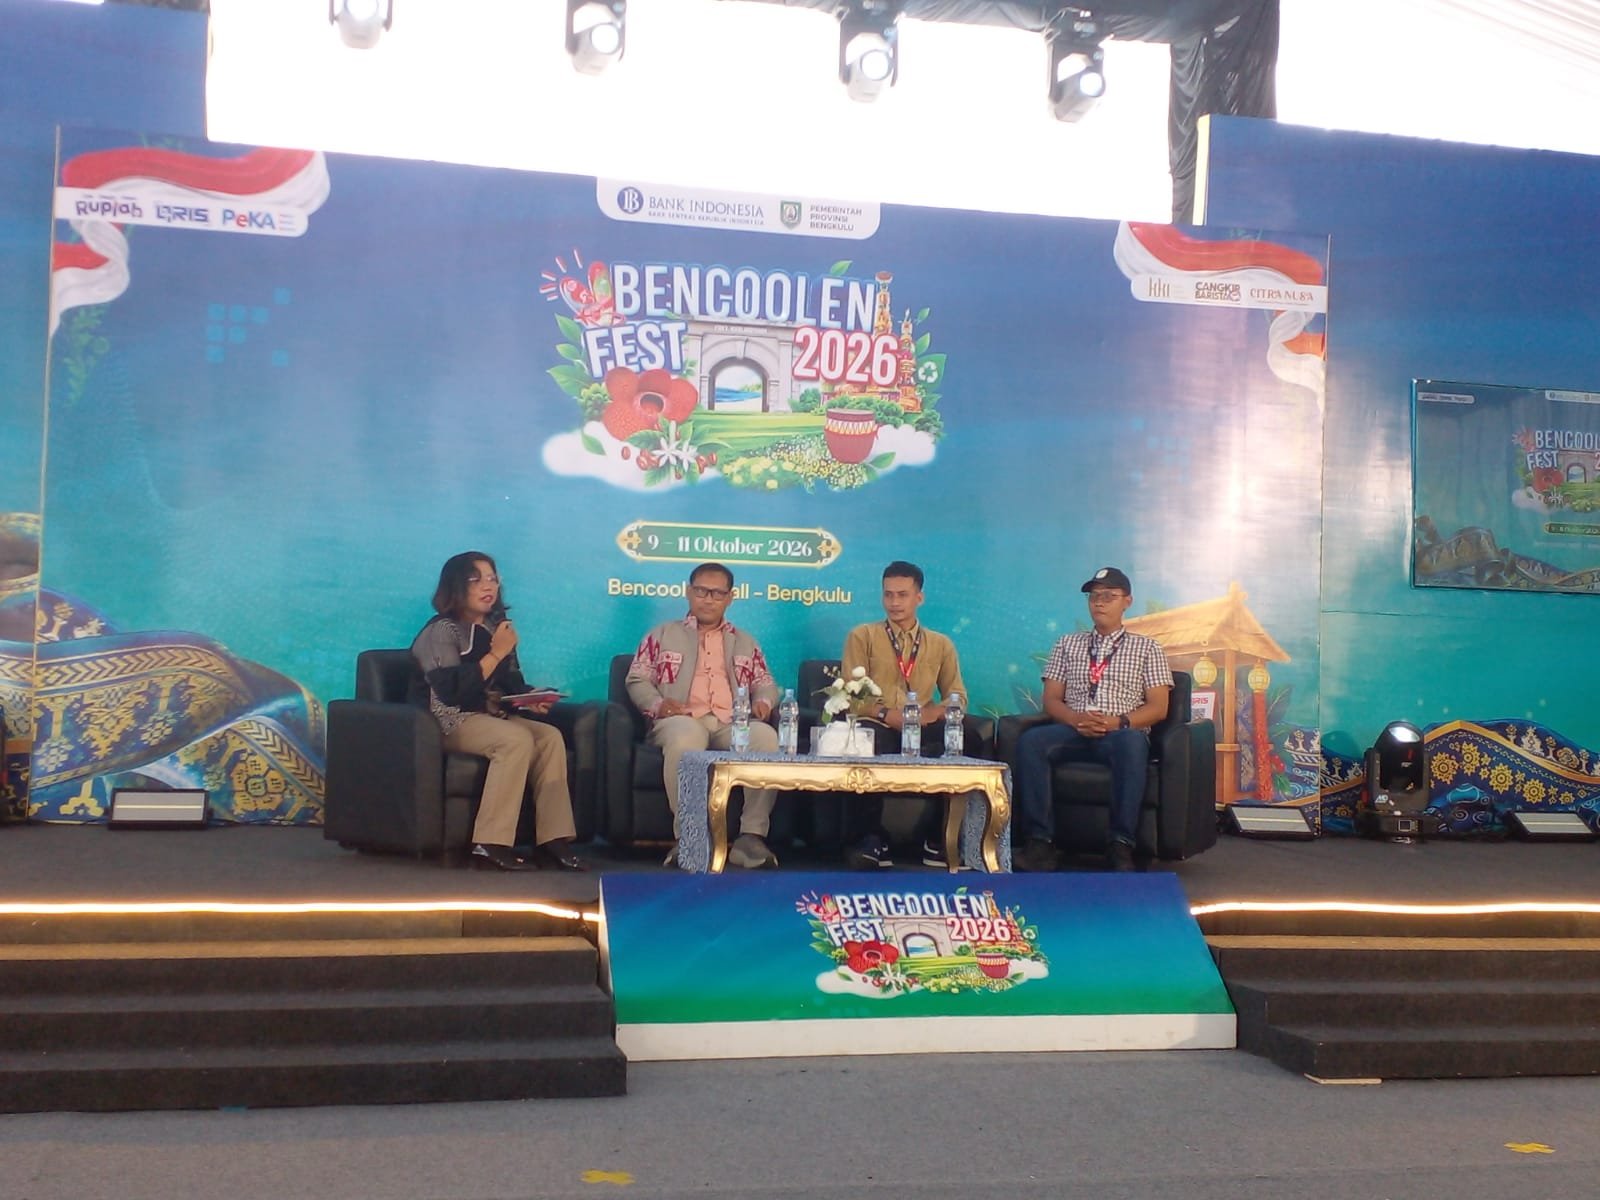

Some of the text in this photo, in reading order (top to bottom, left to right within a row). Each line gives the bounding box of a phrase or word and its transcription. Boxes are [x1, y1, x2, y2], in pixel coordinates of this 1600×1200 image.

[649, 196, 764, 218] BANK INDONESIA
[810, 204, 863, 217] PEMERINTAH
[810, 213, 849, 223] PROVINSI
[222, 209, 276, 230] PeKA
[810, 221, 855, 231] BENGKULU
[1195, 281, 1241, 292] CANGKIR
[1250, 288, 1282, 300] CITRA
[613, 264, 877, 332] BENCOOLEN
[585, 322, 687, 378] FEST
[793, 326, 900, 385] 2026
[1526, 450, 1559, 471] FEST
[648, 535, 659, 550] 9
[677, 536, 690, 552] 11
[694, 536, 764, 555] Oktober
[767, 539, 813, 557] 2026
[608, 578, 686, 597] Bencool
[767, 584, 852, 606] Bengkulu
[836, 893, 988, 918] BENCOOLEN
[828, 918, 885, 947] FEST
[947, 917, 1012, 942] 2026
